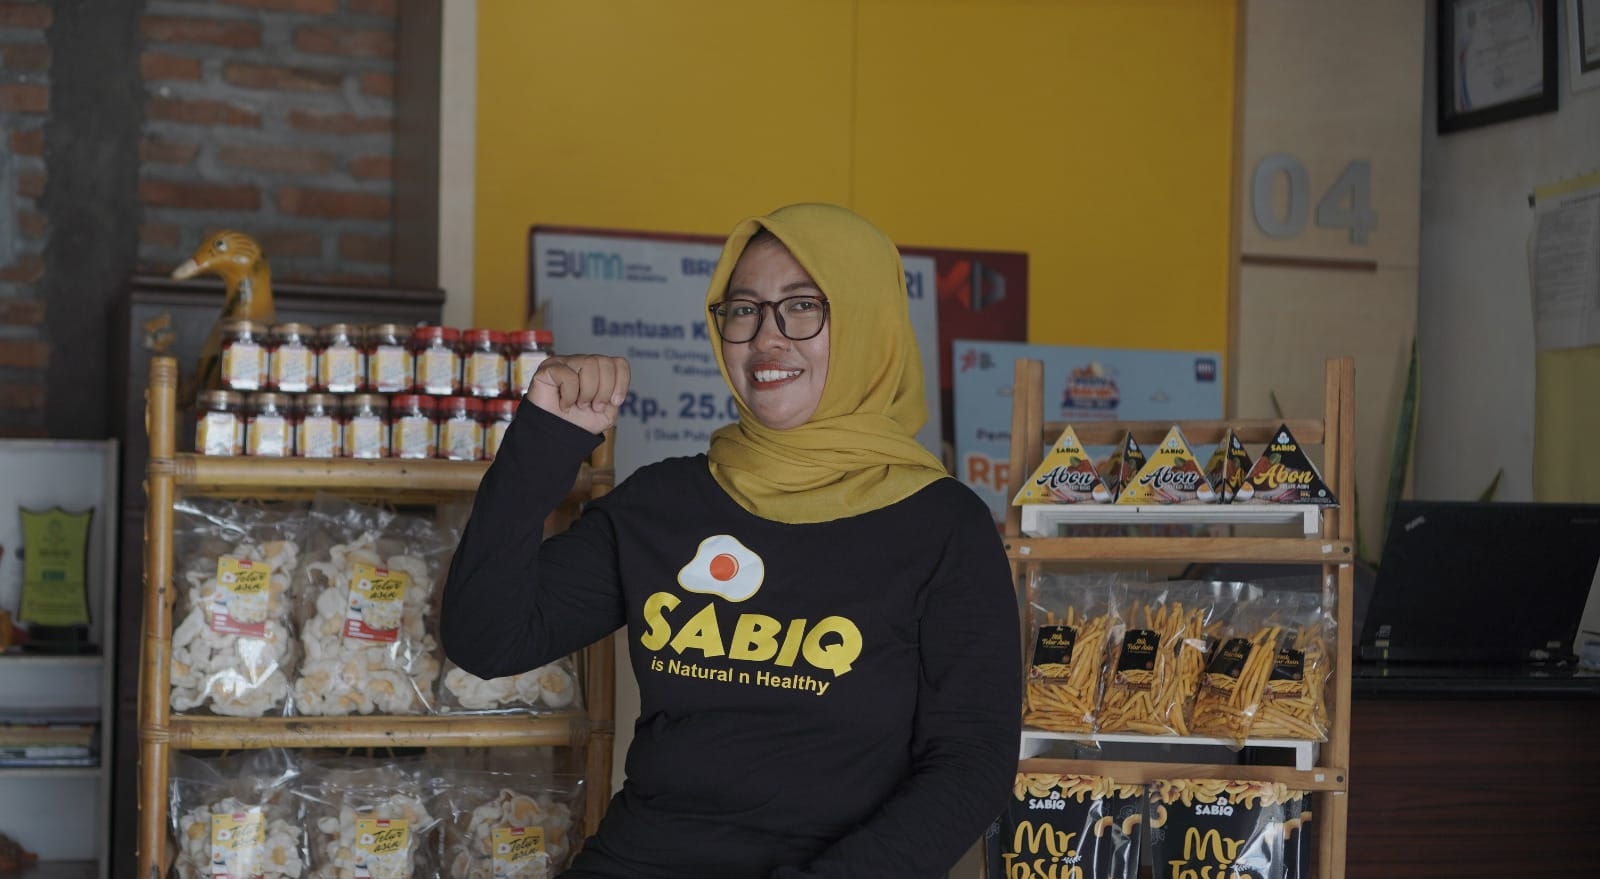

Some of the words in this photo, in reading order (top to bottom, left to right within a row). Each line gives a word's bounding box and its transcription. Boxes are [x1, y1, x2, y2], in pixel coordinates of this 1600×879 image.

[1249, 152, 1378, 246] 04
[592, 315, 685, 339] Bantuan
[693, 321, 710, 341] K
[673, 364, 721, 377] Kabupa
[679, 392, 739, 421] 25.0
[1036, 465, 1094, 488] Abon
[1140, 466, 1198, 488] Abon
[1253, 464, 1313, 489] Abon
[640, 591, 863, 678] SABIQ
[651, 656, 664, 672] is
[668, 659, 733, 682] Natural
[739, 671, 750, 684] n
[756, 670, 830, 696] Healthy
[1028, 799, 1066, 811] SABIQ
[1195, 804, 1234, 817] SABIQ
[1168, 860, 1253, 879] Tsi
